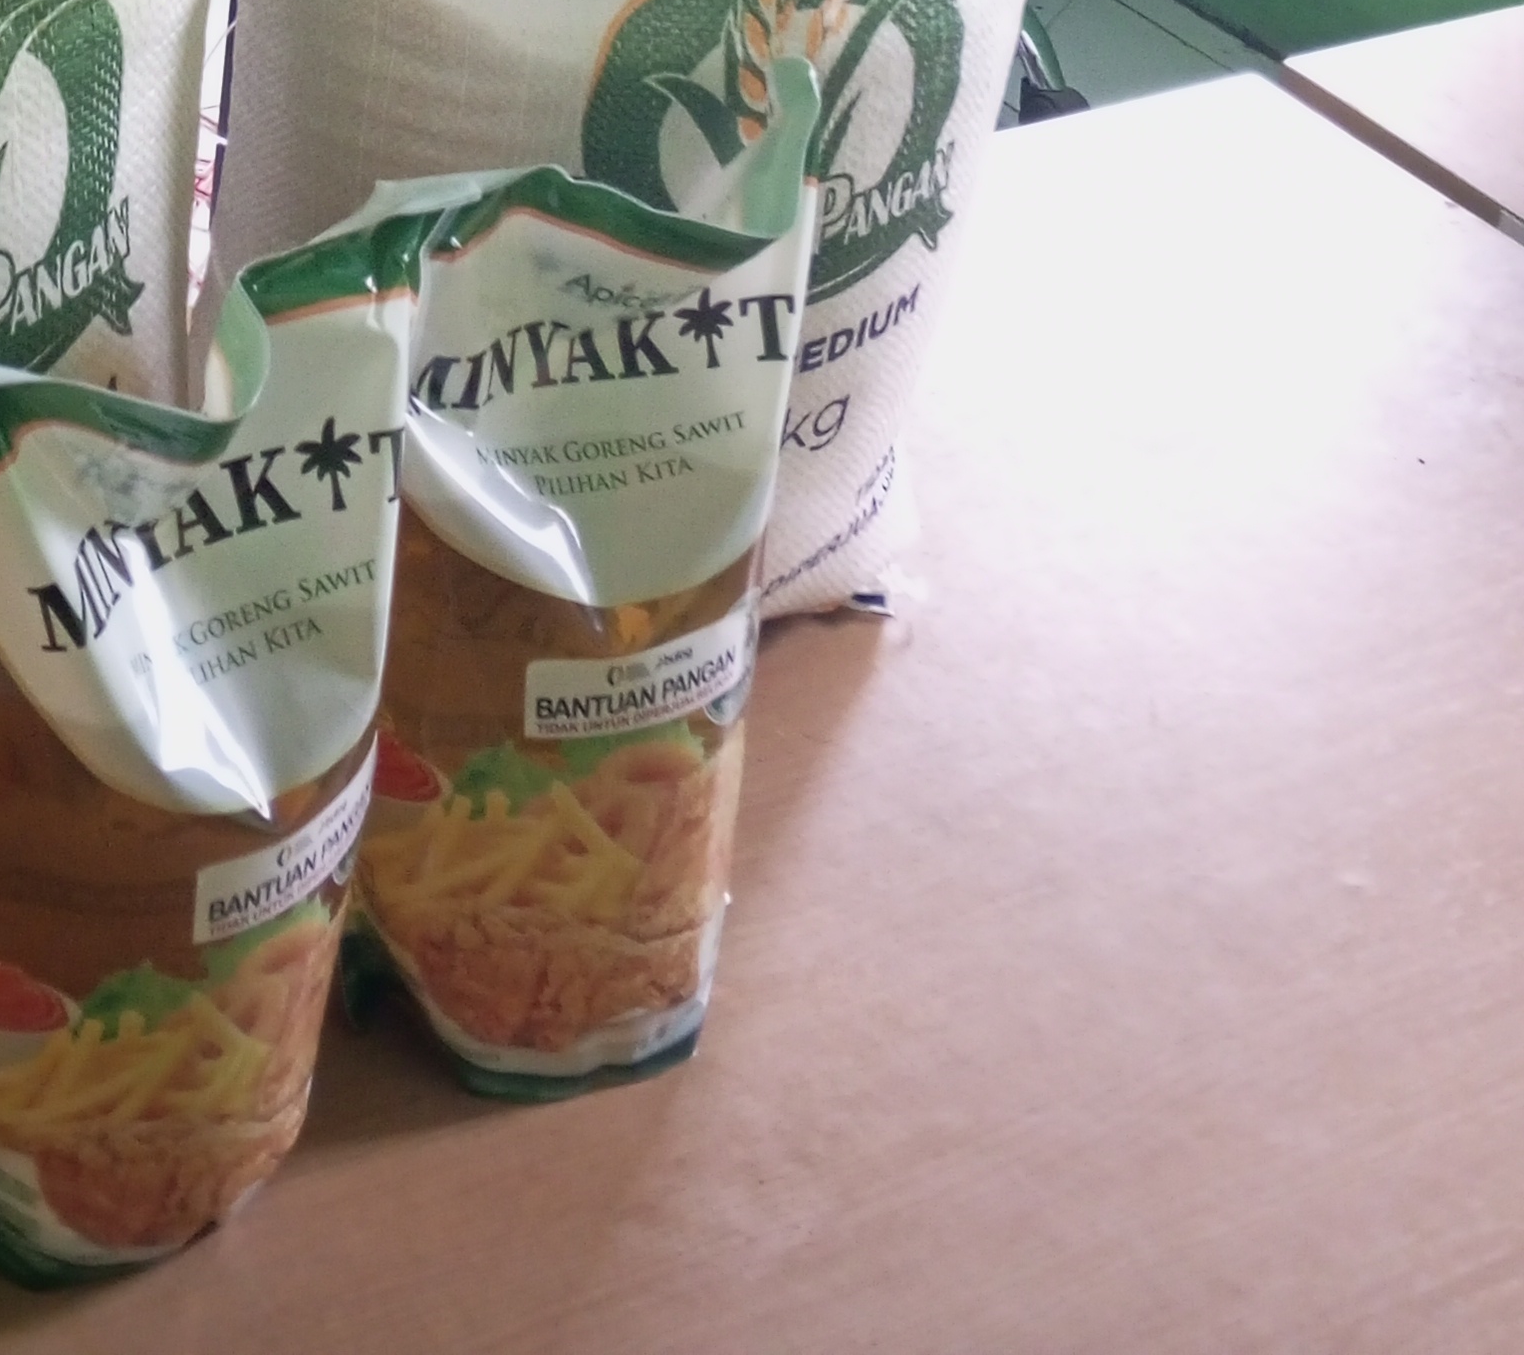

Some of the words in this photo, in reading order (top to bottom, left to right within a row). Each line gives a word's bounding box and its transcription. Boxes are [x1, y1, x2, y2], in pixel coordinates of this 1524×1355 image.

[815, 139, 955, 256] PANGAN
[798, 283, 922, 374] EDIUM
[561, 430, 668, 465] GORENG
[672, 410, 746, 444] SAWIT
[533, 468, 630, 498] PILIHAN
[635, 454, 695, 484] KITA
[188, 588, 293, 648] GORENG
[298, 558, 376, 602] SAWIT
[263, 617, 322, 655] KITA
[535, 683, 657, 720] BANTUAN
[661, 645, 737, 701] PANGAN
[208, 850, 318, 923] BANTUAN
